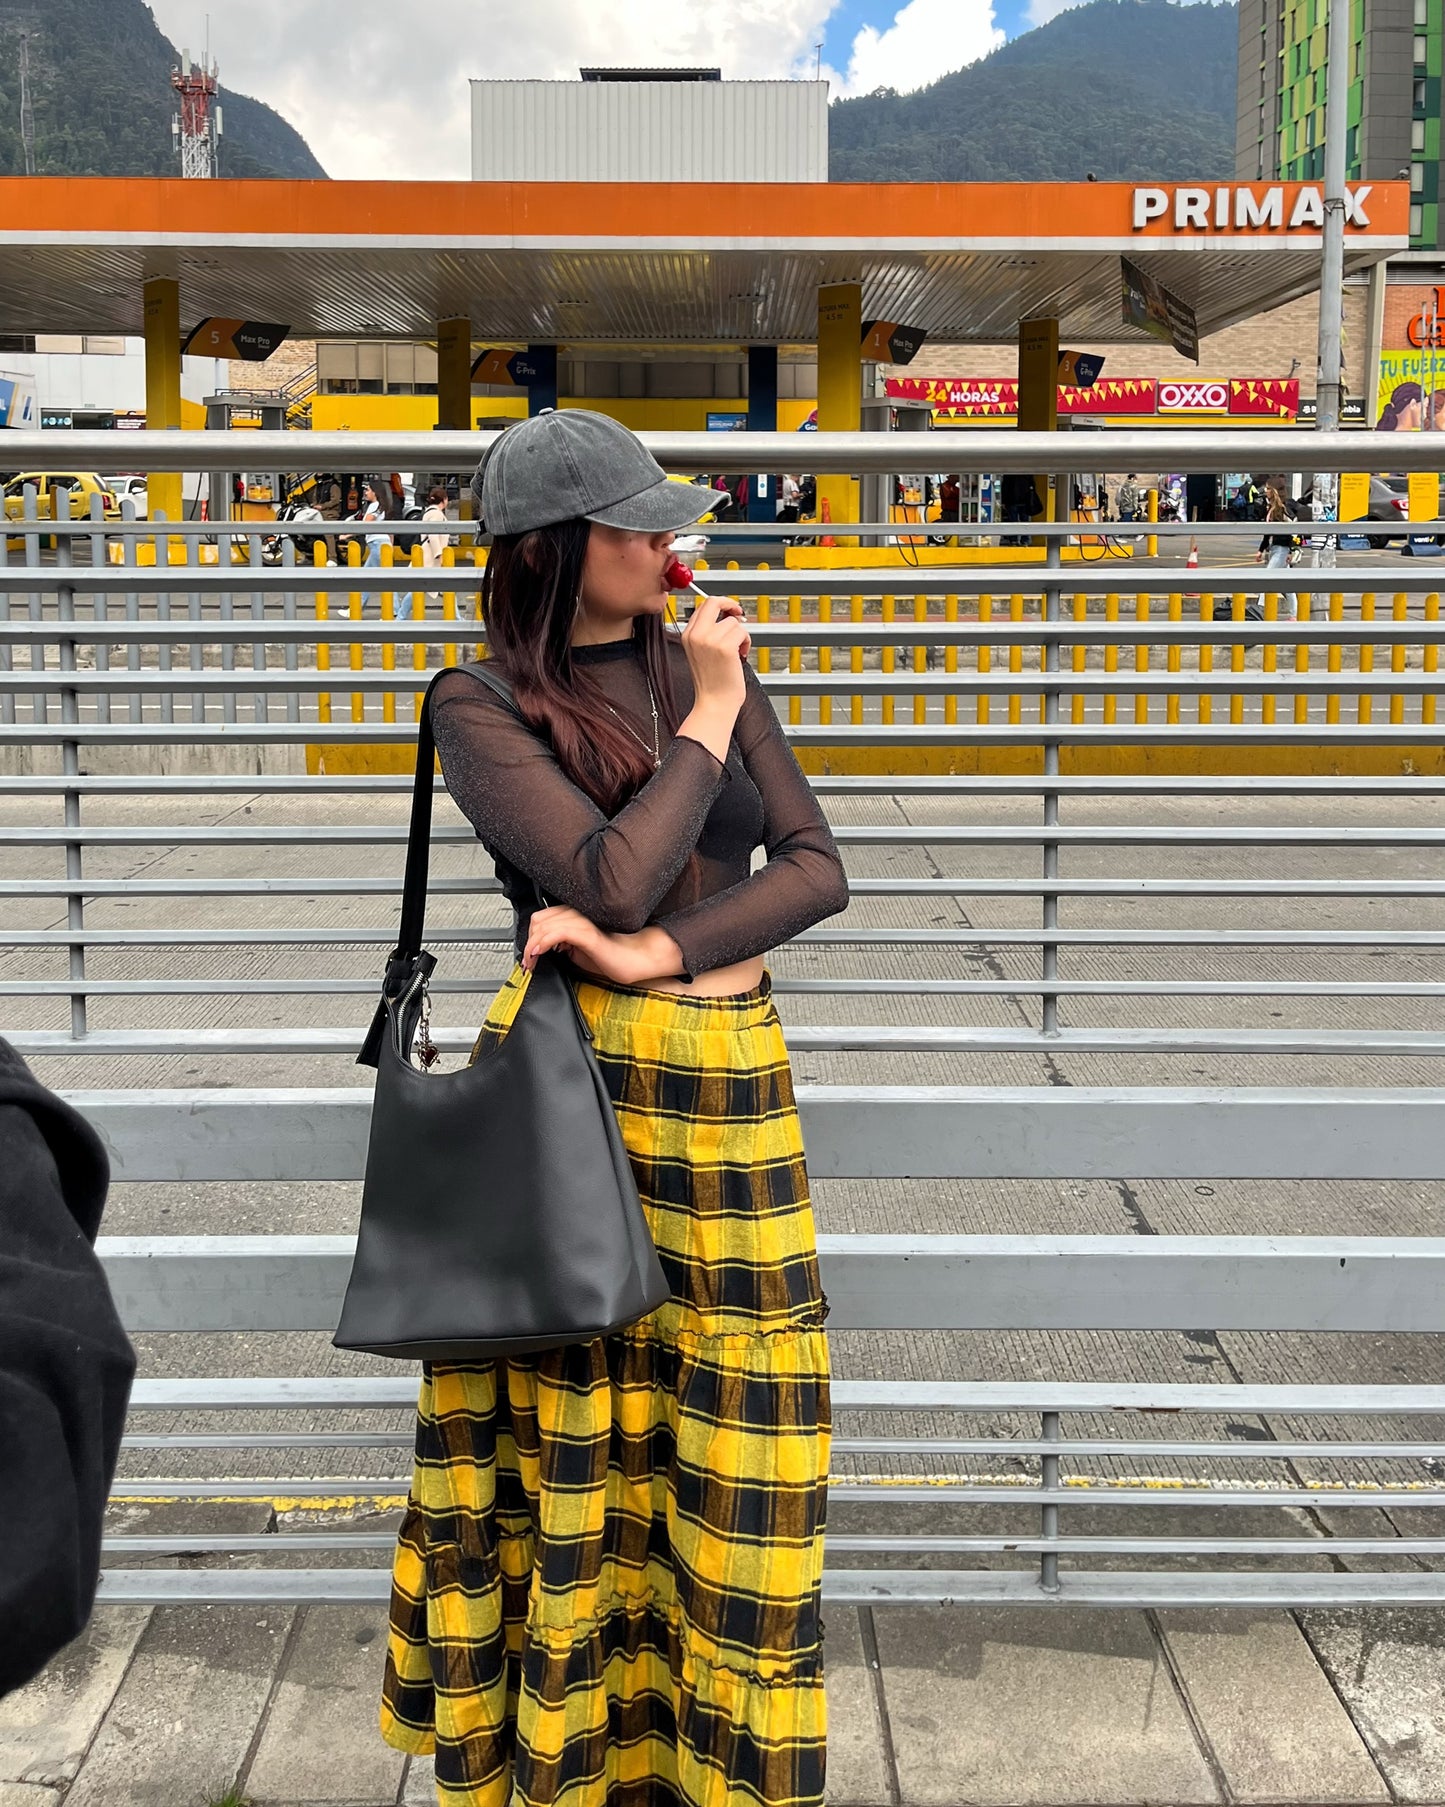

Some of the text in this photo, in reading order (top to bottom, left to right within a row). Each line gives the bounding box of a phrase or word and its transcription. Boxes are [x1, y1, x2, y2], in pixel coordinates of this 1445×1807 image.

[1133, 186, 1373, 230] PRIMAX
[211, 331, 220, 344] 5
[240, 334, 270, 345] Max Pro
[874, 333, 880, 346] 1
[492, 360, 500, 372] 7
[516, 366, 536, 375] G-Prix
[1064, 360, 1070, 372] 3
[1380, 359, 1398, 379] TU
[926, 389, 1000, 403] 24 HORAS
[1160, 384, 1227, 407] OXXO
